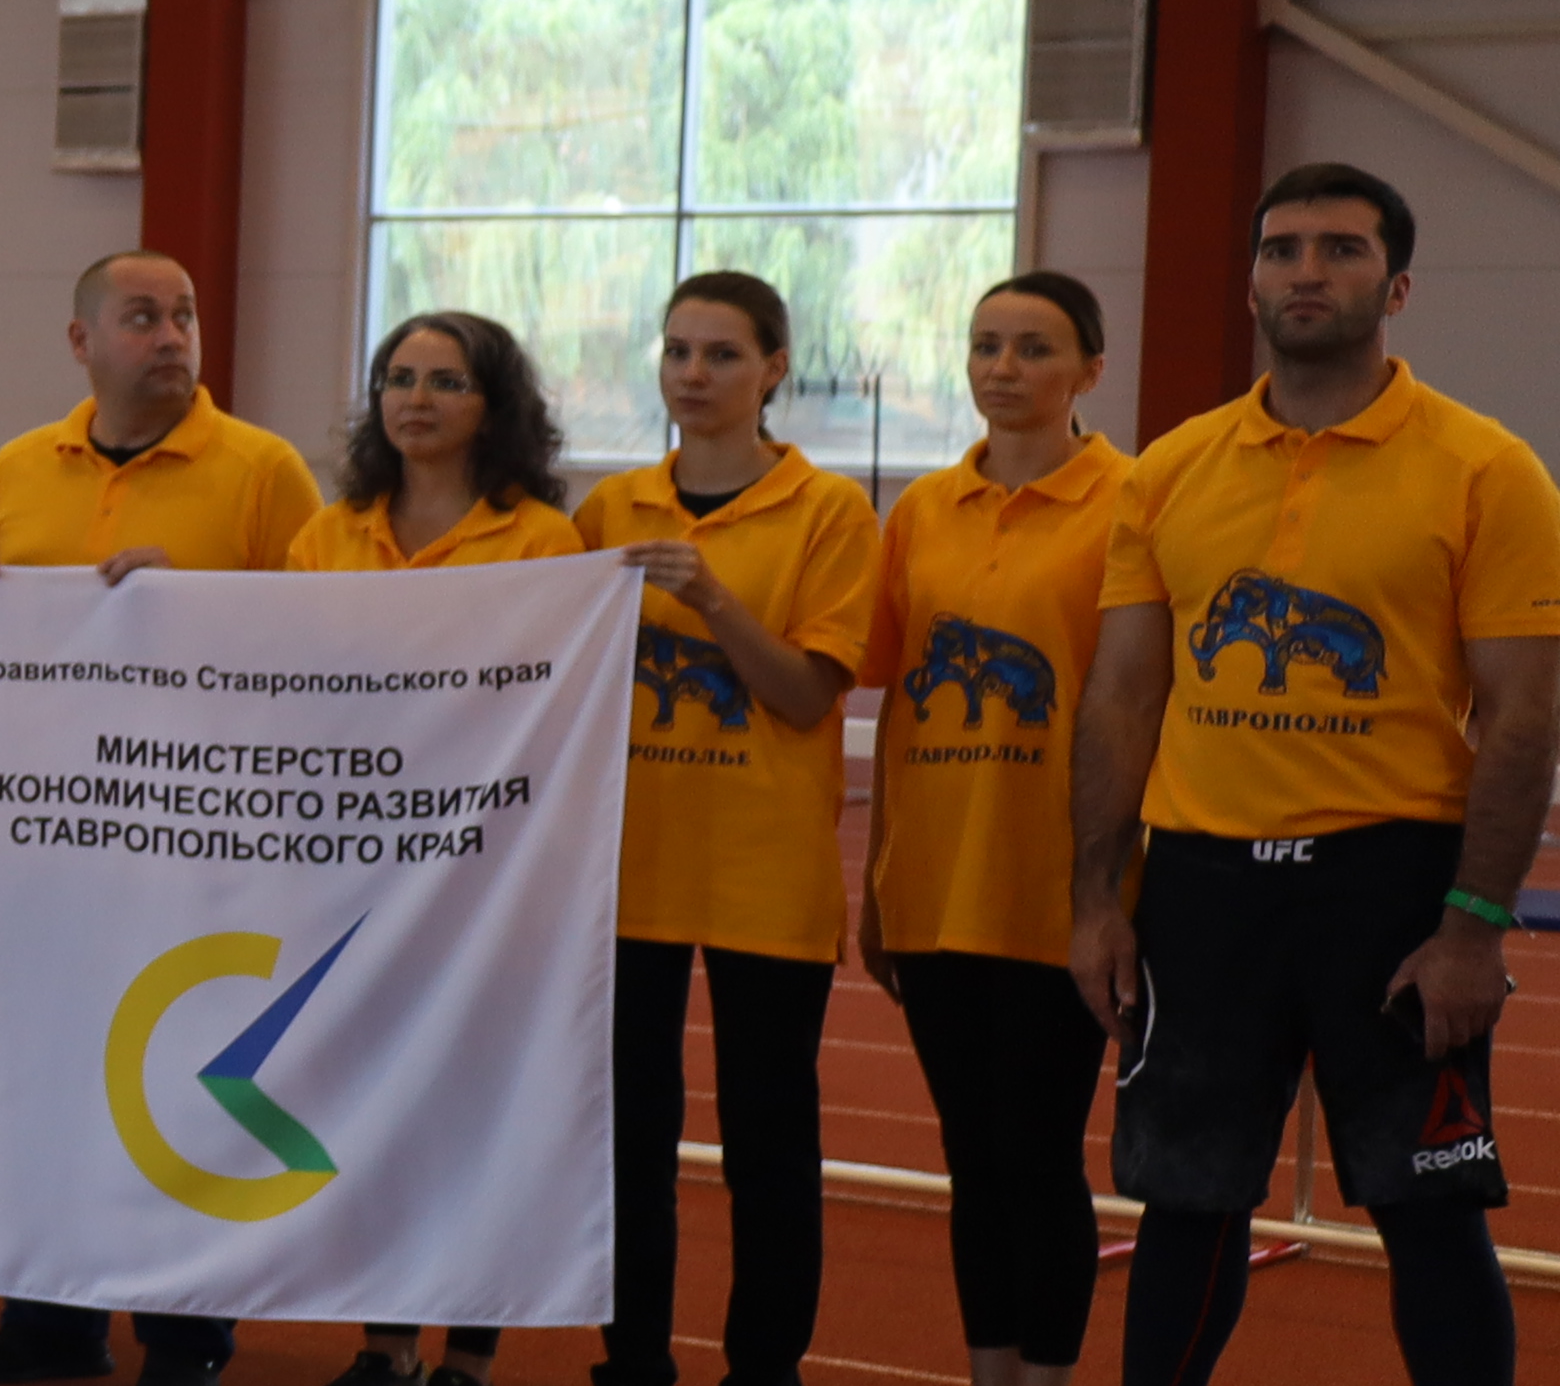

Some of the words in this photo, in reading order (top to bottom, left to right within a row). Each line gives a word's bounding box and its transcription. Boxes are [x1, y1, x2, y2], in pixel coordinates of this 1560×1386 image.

[196, 665, 468, 697] Ставропольского
[478, 661, 552, 691] края
[1187, 706, 1374, 735] СТАВРОПОЛЬЕ
[96, 734, 404, 777] МИНИСТЕРСТВО
[629, 744, 751, 766] РОПОЛЬЕ
[337, 775, 531, 821] РАЗВИТИЯ
[10, 815, 384, 864] СТАВРОПОЛЬСКОГО
[396, 825, 484, 863] КРАЯ
[1251, 837, 1315, 863] UFC
